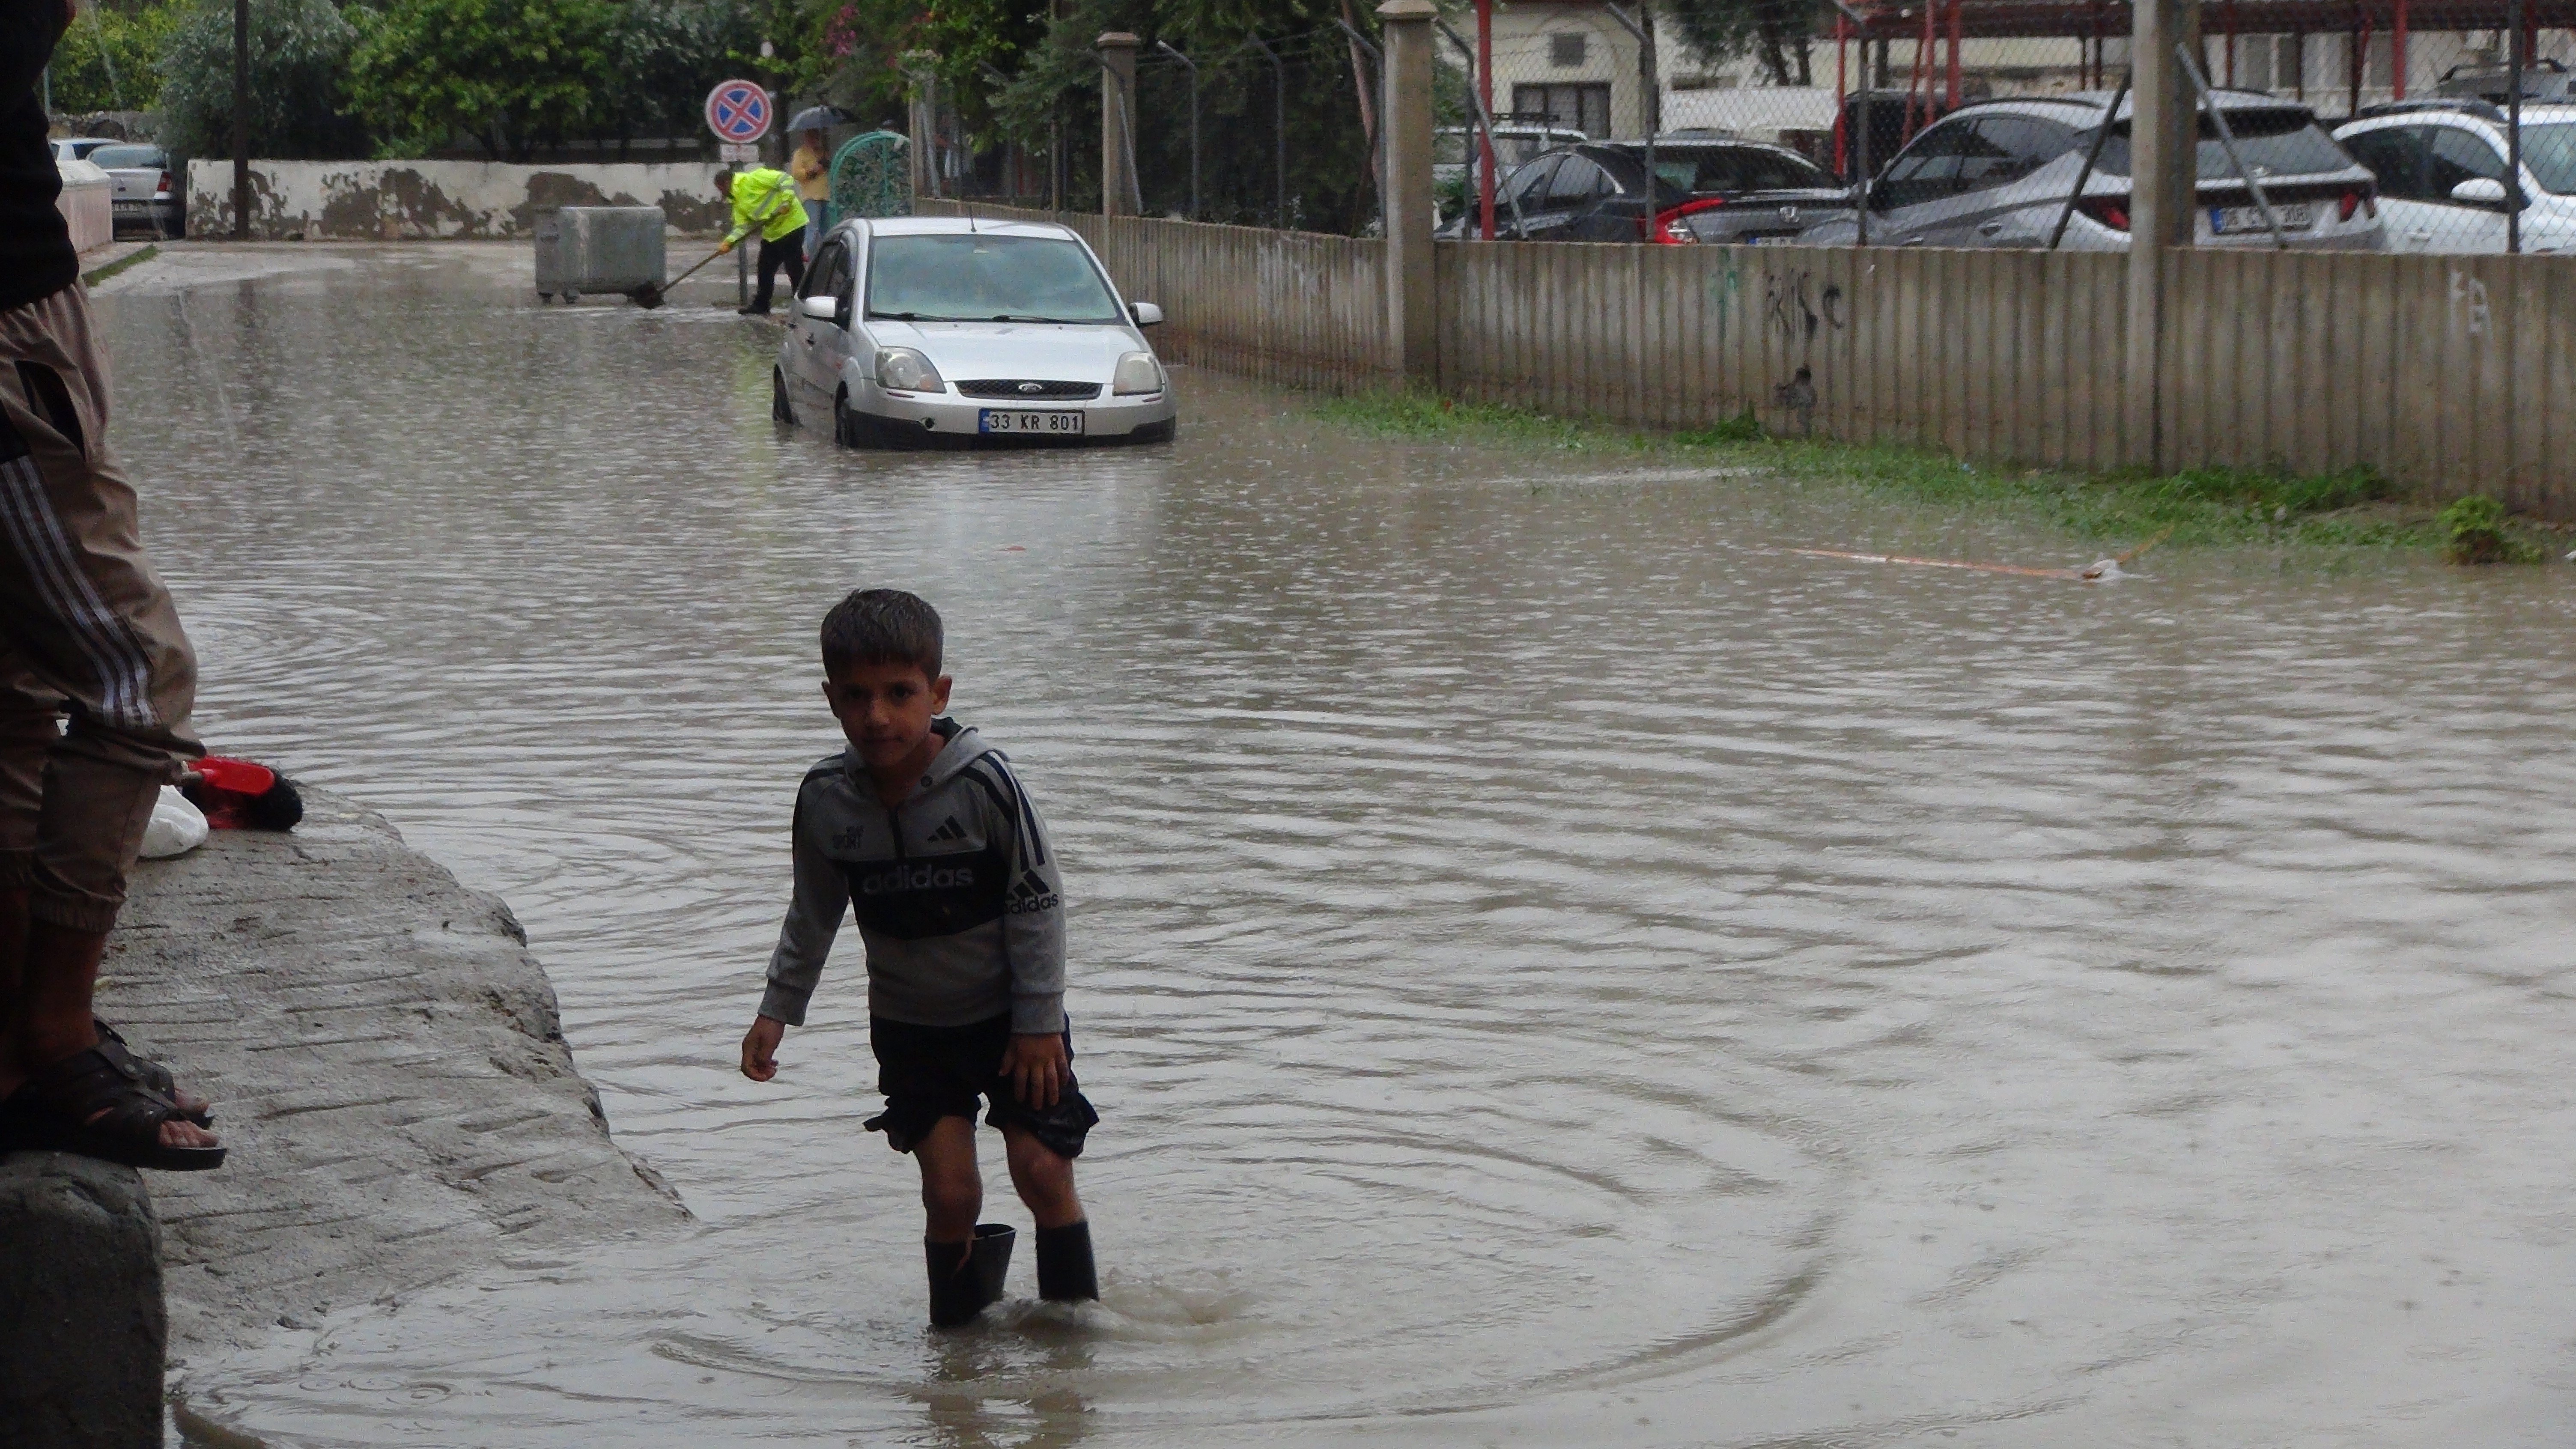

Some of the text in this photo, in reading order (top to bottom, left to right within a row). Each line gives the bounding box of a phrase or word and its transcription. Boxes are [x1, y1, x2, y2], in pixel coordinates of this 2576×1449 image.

[990, 414, 1011, 429] 33
[1021, 414, 1040, 429] KR
[1049, 415, 1078, 430] 801
[862, 863, 975, 895] adidas
